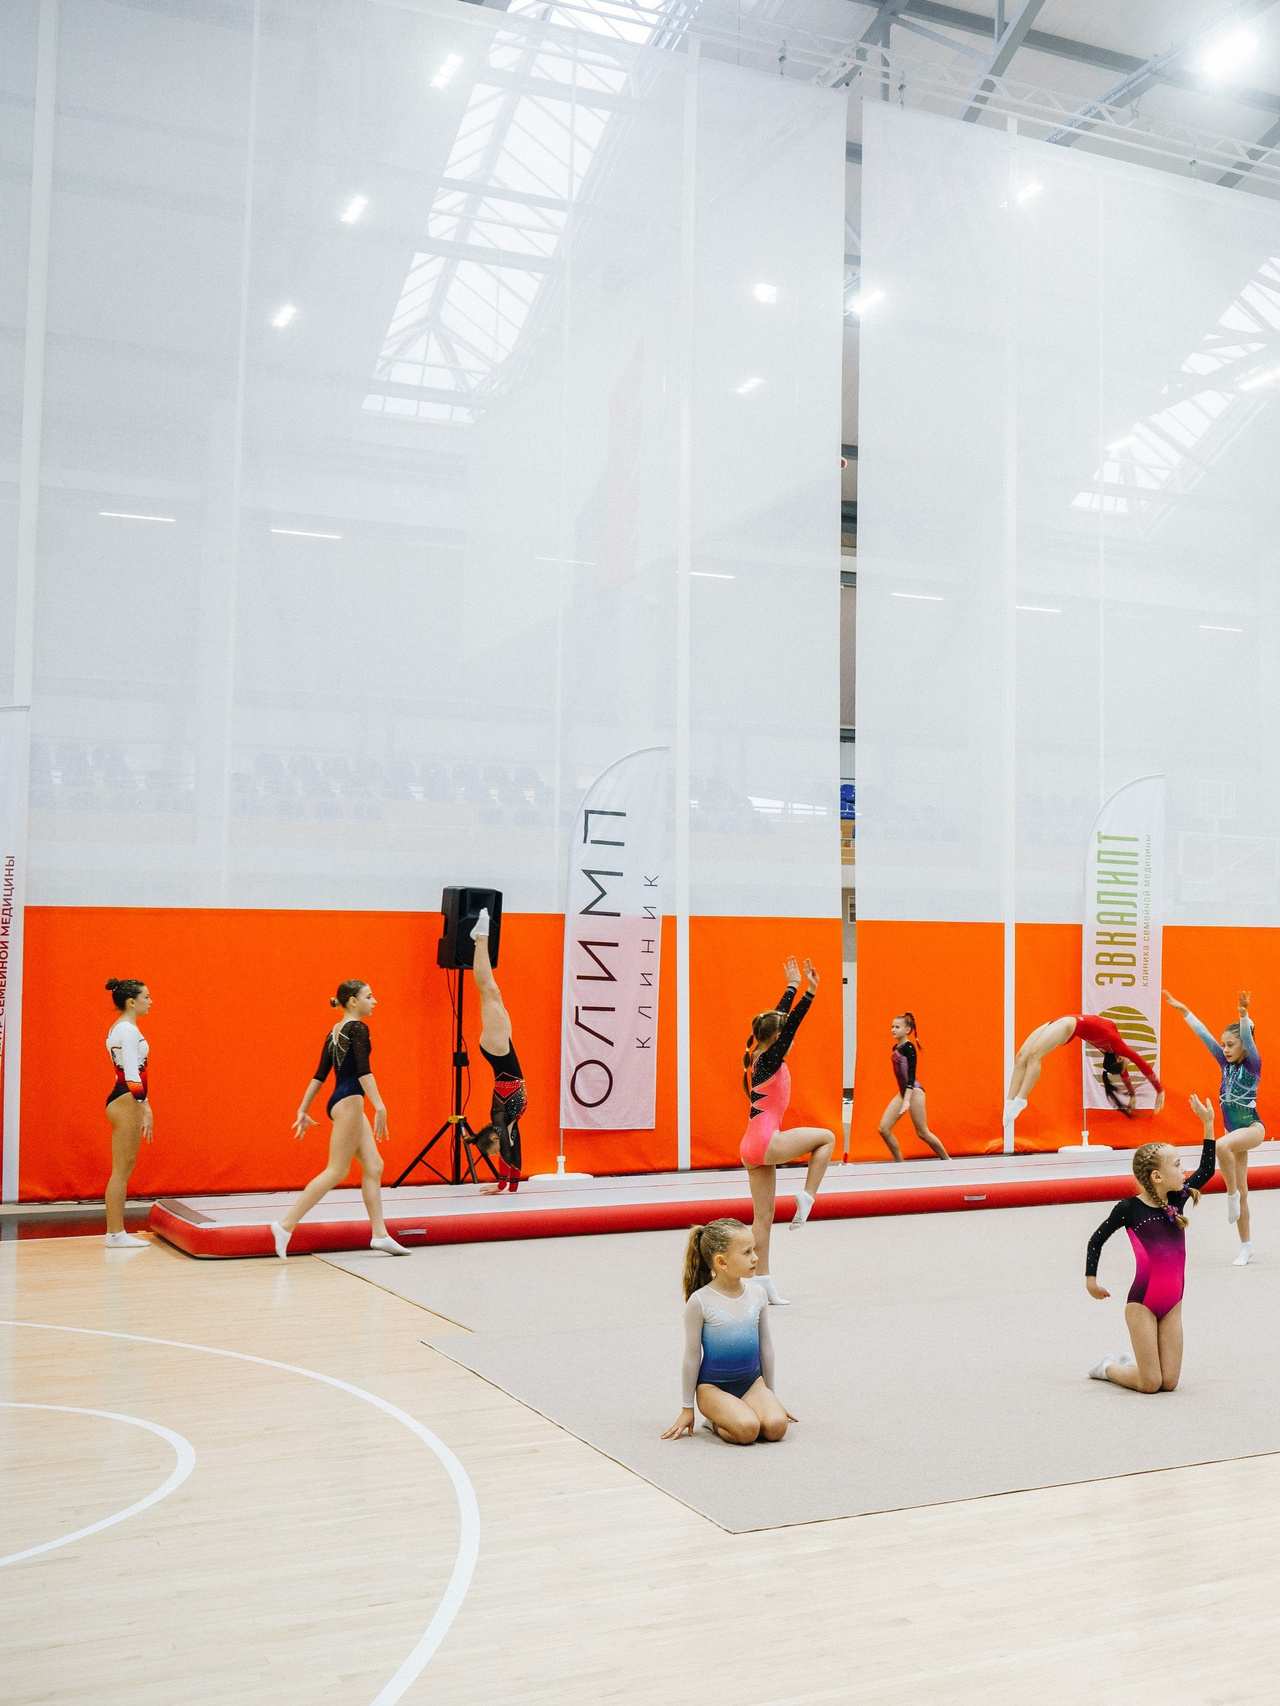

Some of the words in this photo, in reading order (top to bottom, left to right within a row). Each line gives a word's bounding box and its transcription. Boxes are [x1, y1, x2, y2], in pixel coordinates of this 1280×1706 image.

[1, 856, 15, 936] МЕДИЦИНЫ
[1144, 834, 1152, 887] медицины
[1095, 831, 1139, 987] ЭВКАЛИПТ
[1143, 890, 1151, 942] семейной
[571, 810, 626, 1108] ОЛИМП
[636, 875, 658, 1048] КЛИНИК
[1142, 945, 1150, 987] клиника
